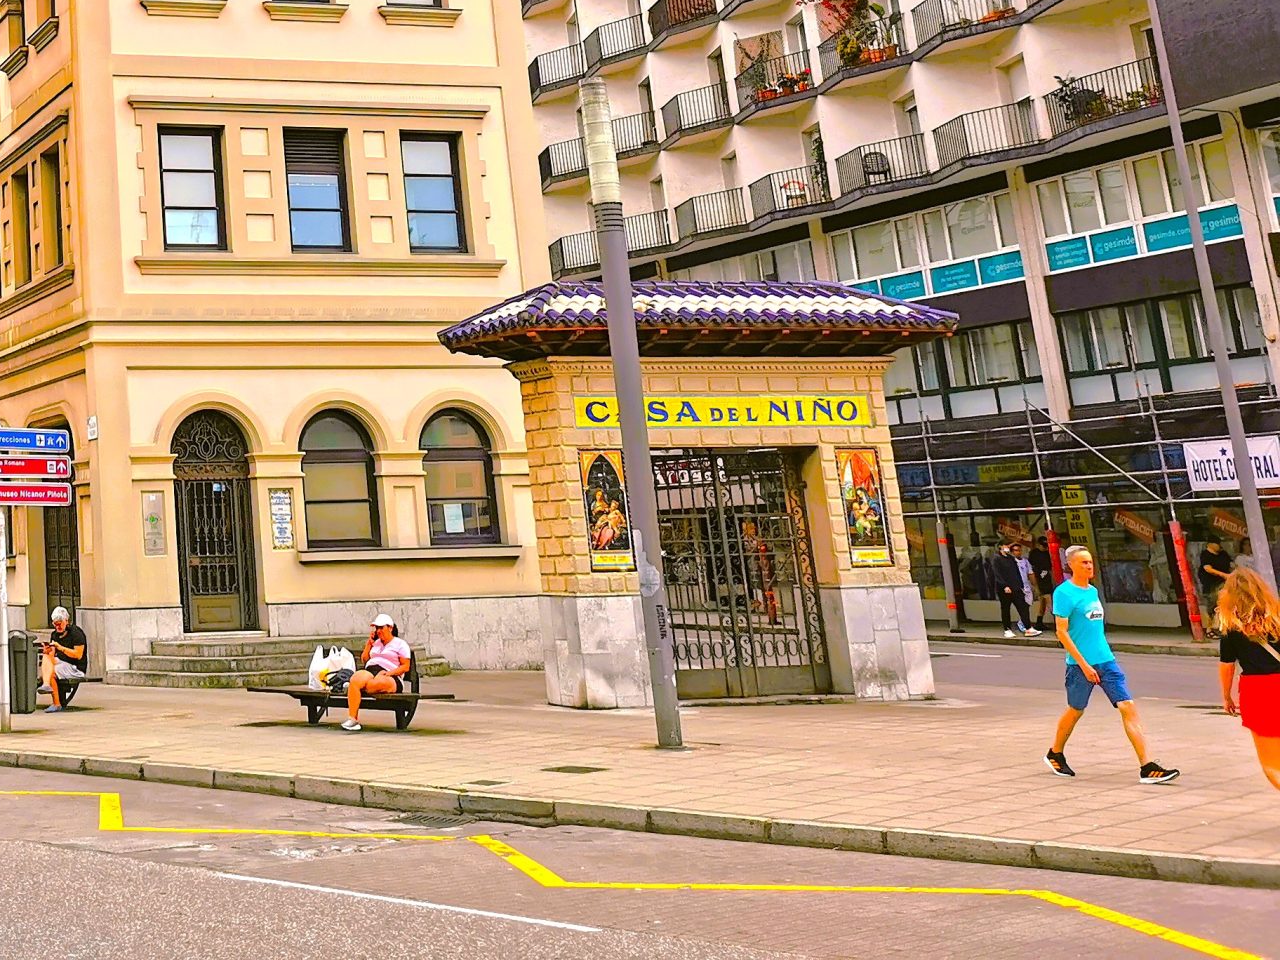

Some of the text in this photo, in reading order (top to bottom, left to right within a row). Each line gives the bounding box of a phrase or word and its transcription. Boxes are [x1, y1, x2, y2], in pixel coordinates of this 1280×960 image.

[1209, 215, 1240, 230] gesimd
[585, 398, 858, 422] CSA DEL NIÑO
[1192, 455, 1279, 482] HOTEL CRAL
[47, 490, 67, 498] Piñole
